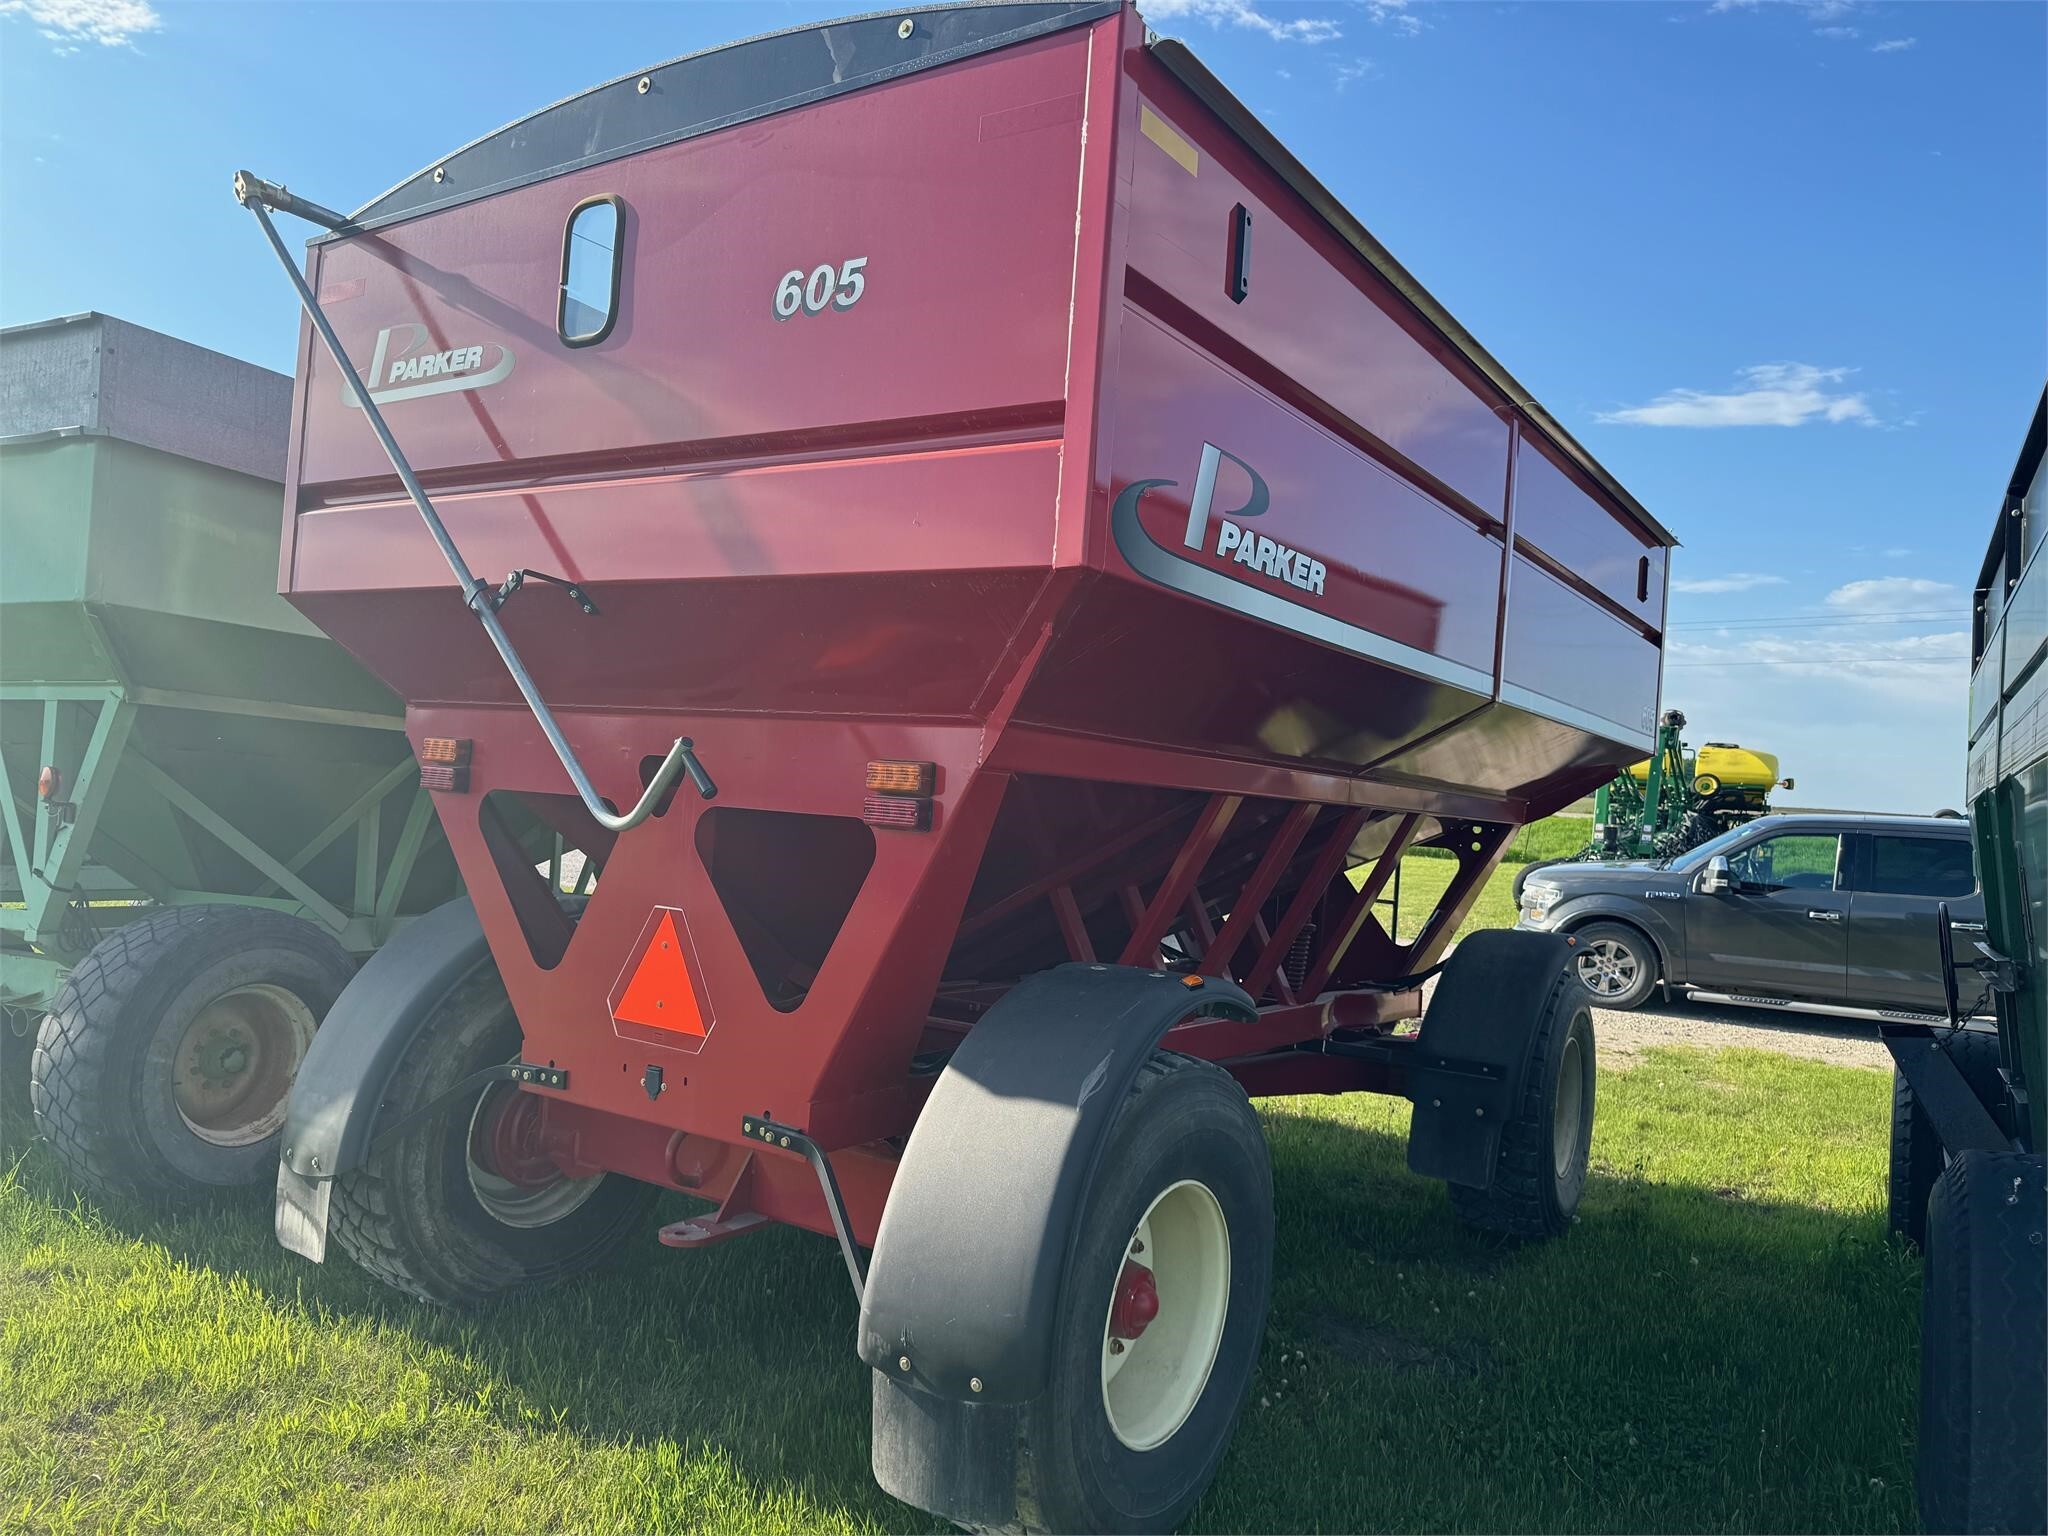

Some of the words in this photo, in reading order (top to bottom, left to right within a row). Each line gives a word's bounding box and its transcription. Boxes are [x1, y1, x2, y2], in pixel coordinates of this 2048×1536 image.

[772, 256, 868, 321] 605
[388, 345, 484, 384] PARKER
[1215, 519, 1327, 596] PARKER
